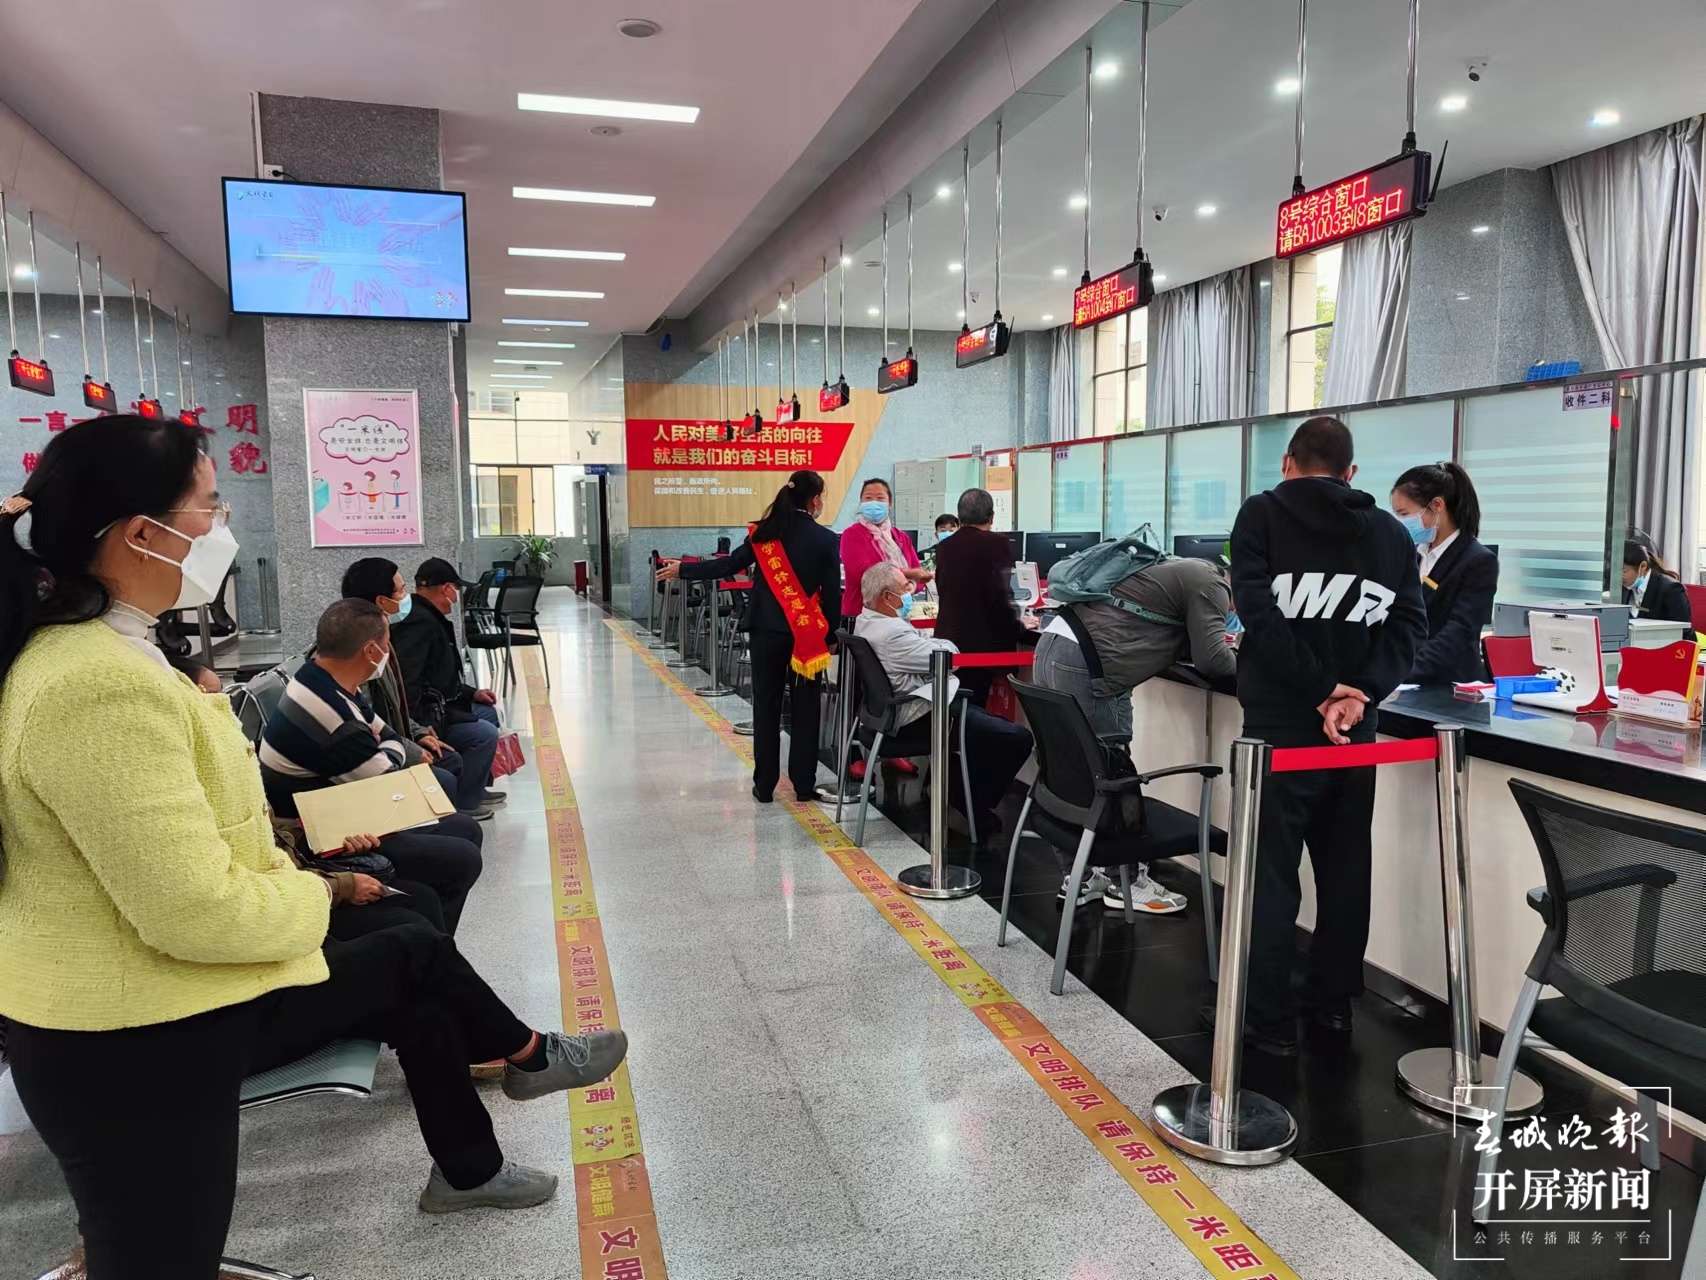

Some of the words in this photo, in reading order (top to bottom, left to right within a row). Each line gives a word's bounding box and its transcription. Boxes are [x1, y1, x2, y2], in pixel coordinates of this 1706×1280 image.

[1279, 190, 1402, 253] 请BA1003到8窗口
[1280, 176, 1368, 229] 8号综合窗口
[1565, 391, 1610, 407] 收件二科
[1021, 1042, 1104, 1111] 文明排队
